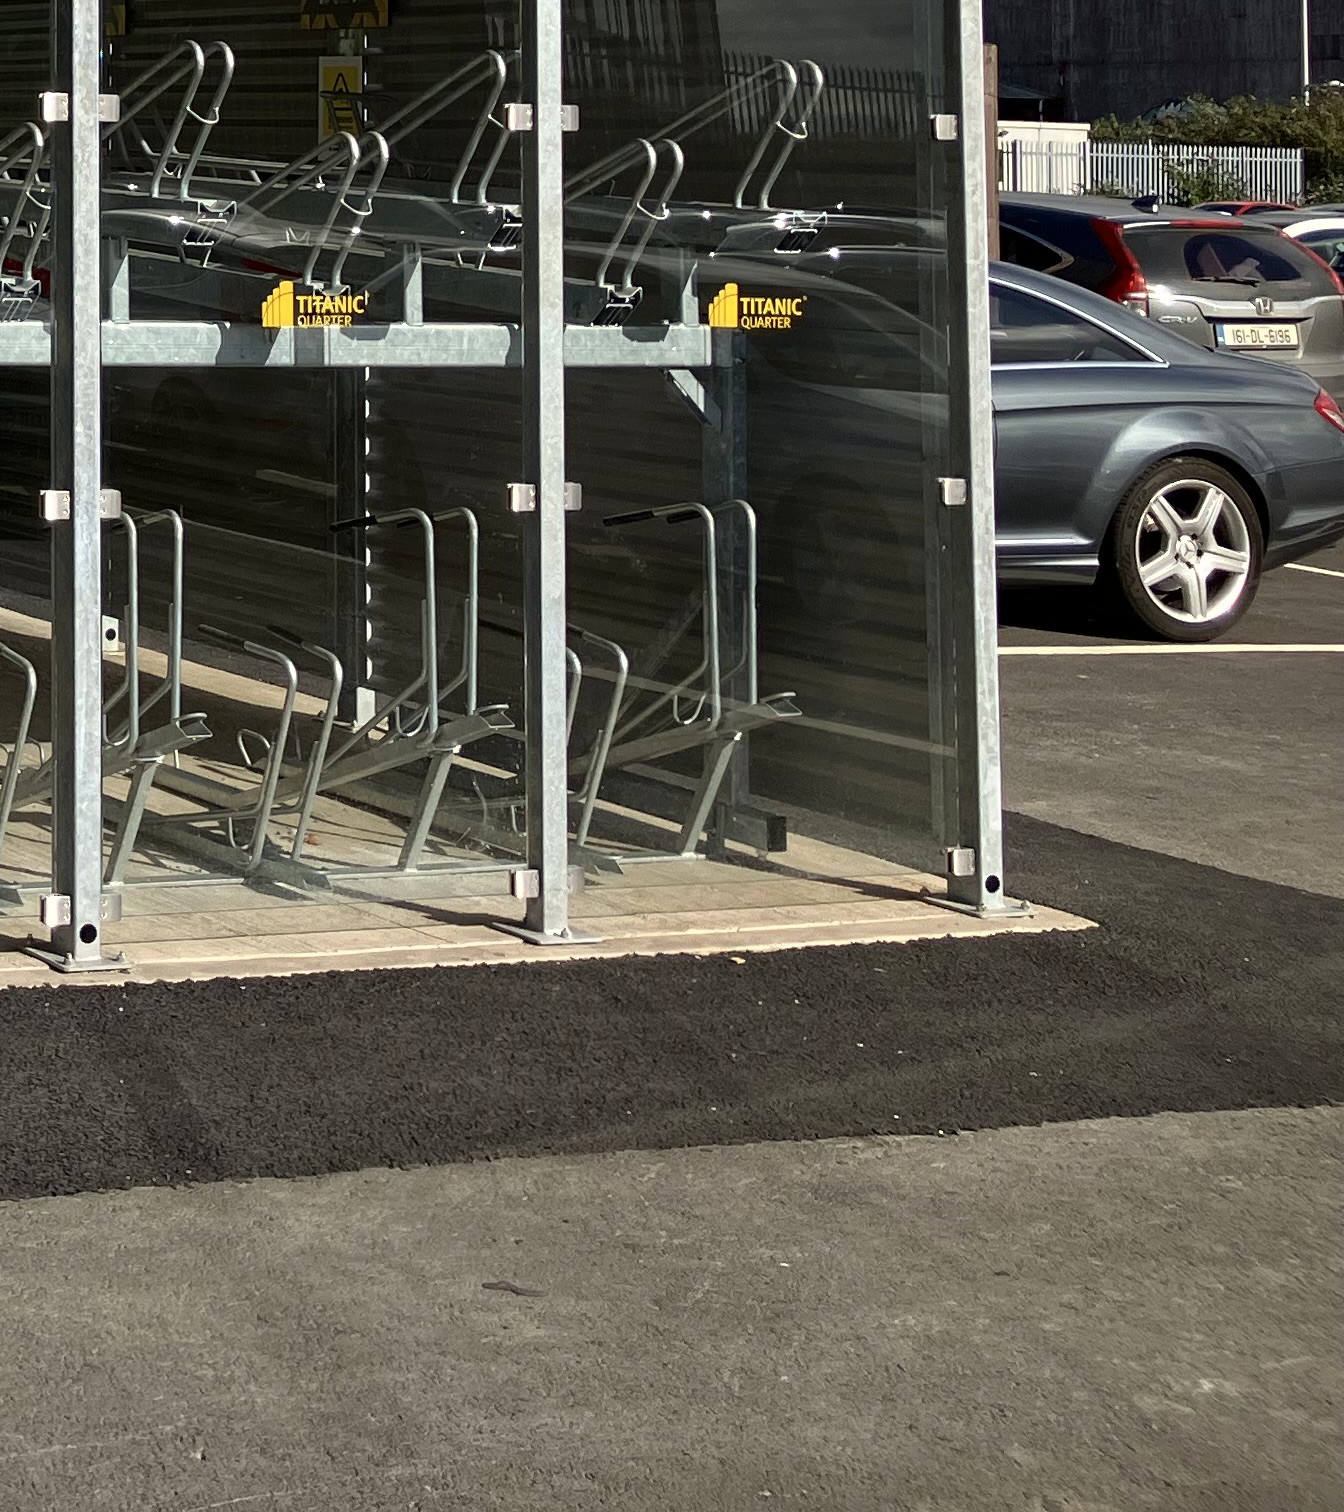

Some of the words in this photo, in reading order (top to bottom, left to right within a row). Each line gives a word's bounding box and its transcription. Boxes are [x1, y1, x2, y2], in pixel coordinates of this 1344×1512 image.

[296, 295, 365, 314] TITANIC
[740, 297, 802, 316] TITANIC
[298, 315, 352, 329] QUARTER
[740, 316, 791, 329] QUARTER
[1232, 329, 1291, 344] 161-DL-6196
